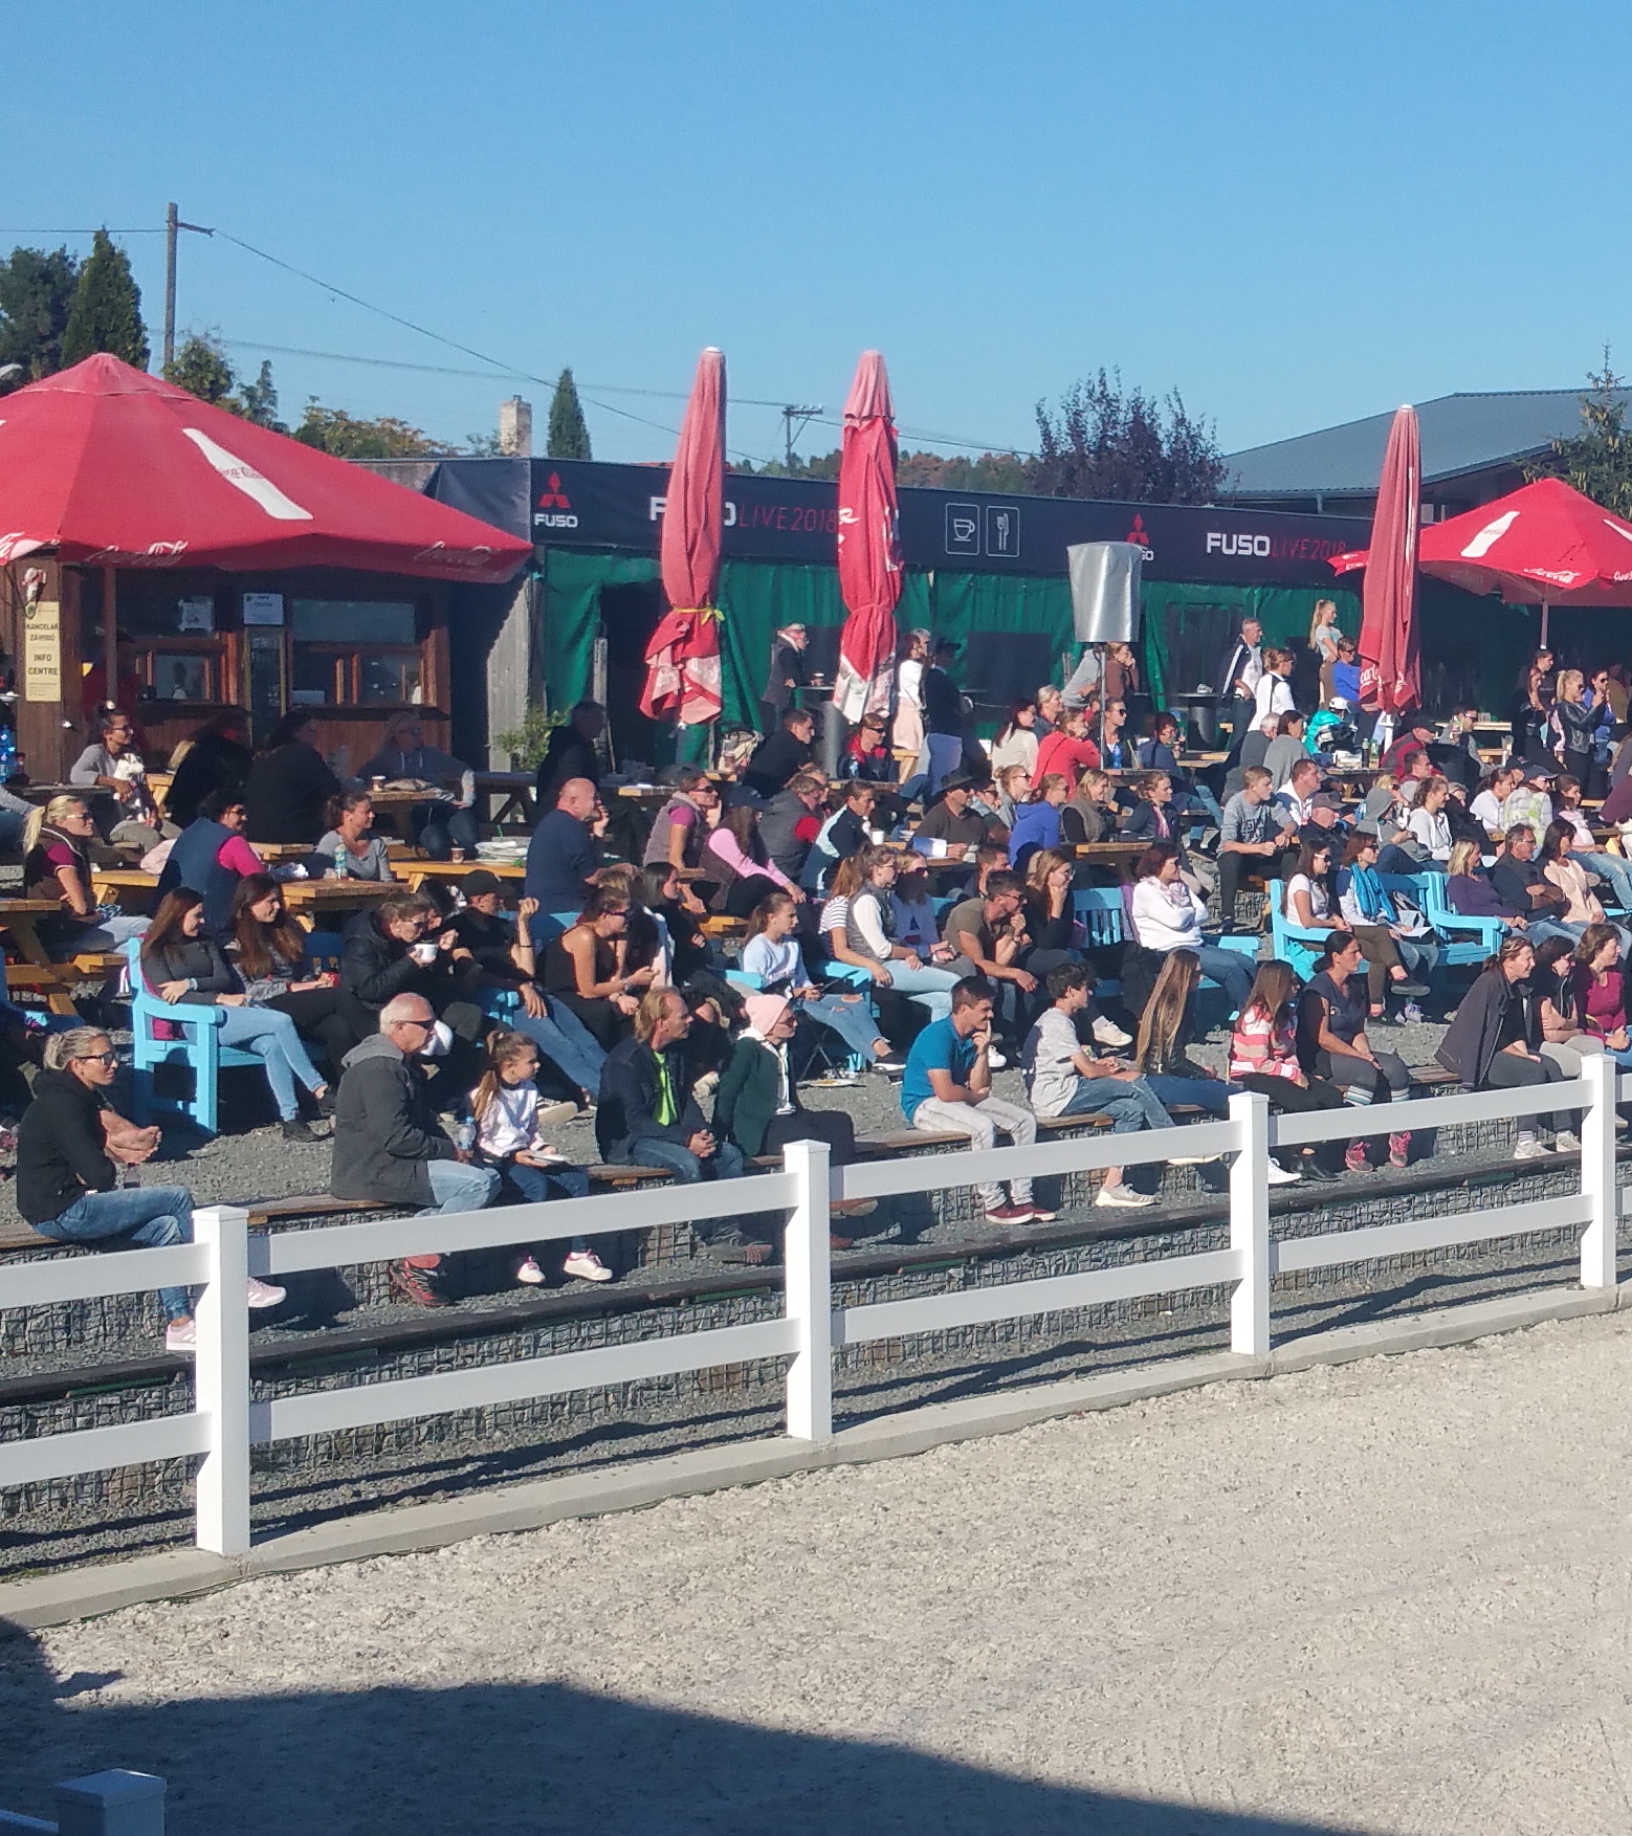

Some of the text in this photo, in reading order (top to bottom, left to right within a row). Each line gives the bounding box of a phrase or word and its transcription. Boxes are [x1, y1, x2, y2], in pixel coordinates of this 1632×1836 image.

[534, 513, 578, 528] FUSO
[1206, 532, 1270, 557] FUSO
[34, 654, 52, 662] INFO
[28, 667, 58, 675] CENTRE
